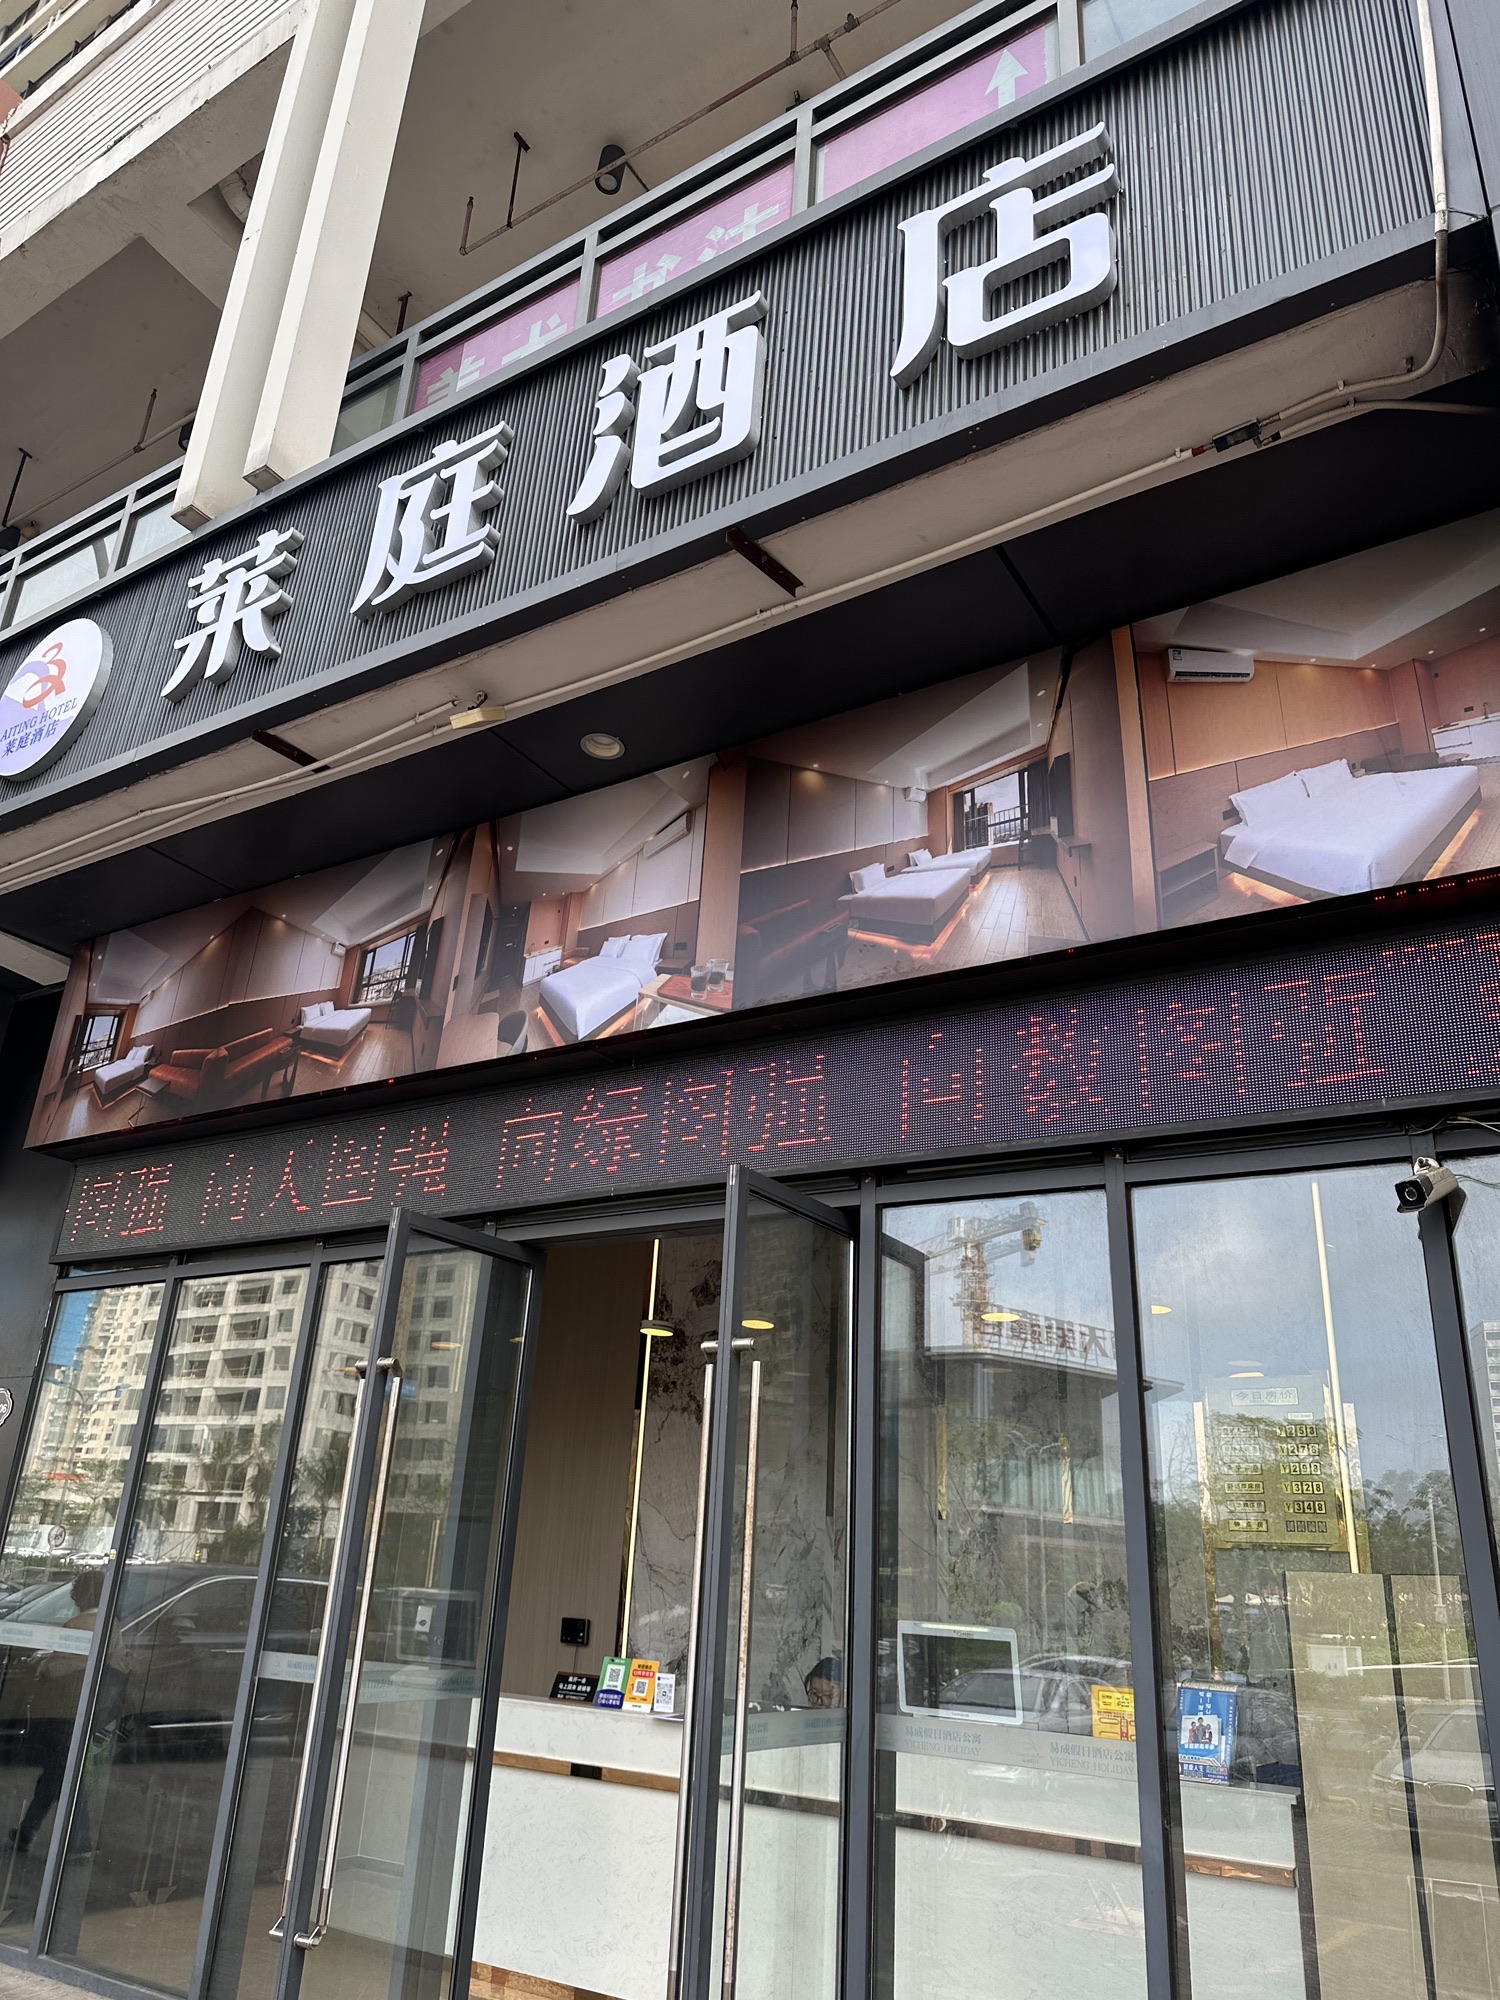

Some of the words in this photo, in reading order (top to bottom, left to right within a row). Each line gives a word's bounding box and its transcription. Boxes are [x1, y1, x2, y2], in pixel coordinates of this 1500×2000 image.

[162, 120, 1118, 701] 莱庭酒店
[39, 697, 78, 724] HOTEL
[1, 719, 60, 759] 莱庭酒店
[1236, 1390, 1293, 1401] 今日房价
[905, 1725, 982, 1745] 易成假日酒店公寓
[904, 1739, 941, 1752] YICHENG
[943, 1743, 981, 1756] HOLIDAY
[1050, 1741, 1135, 1763] 易成假日酒店公寓
[1049, 1756, 1090, 1770] YICHENG
[1093, 1761, 1136, 1776] HOLIDAY
